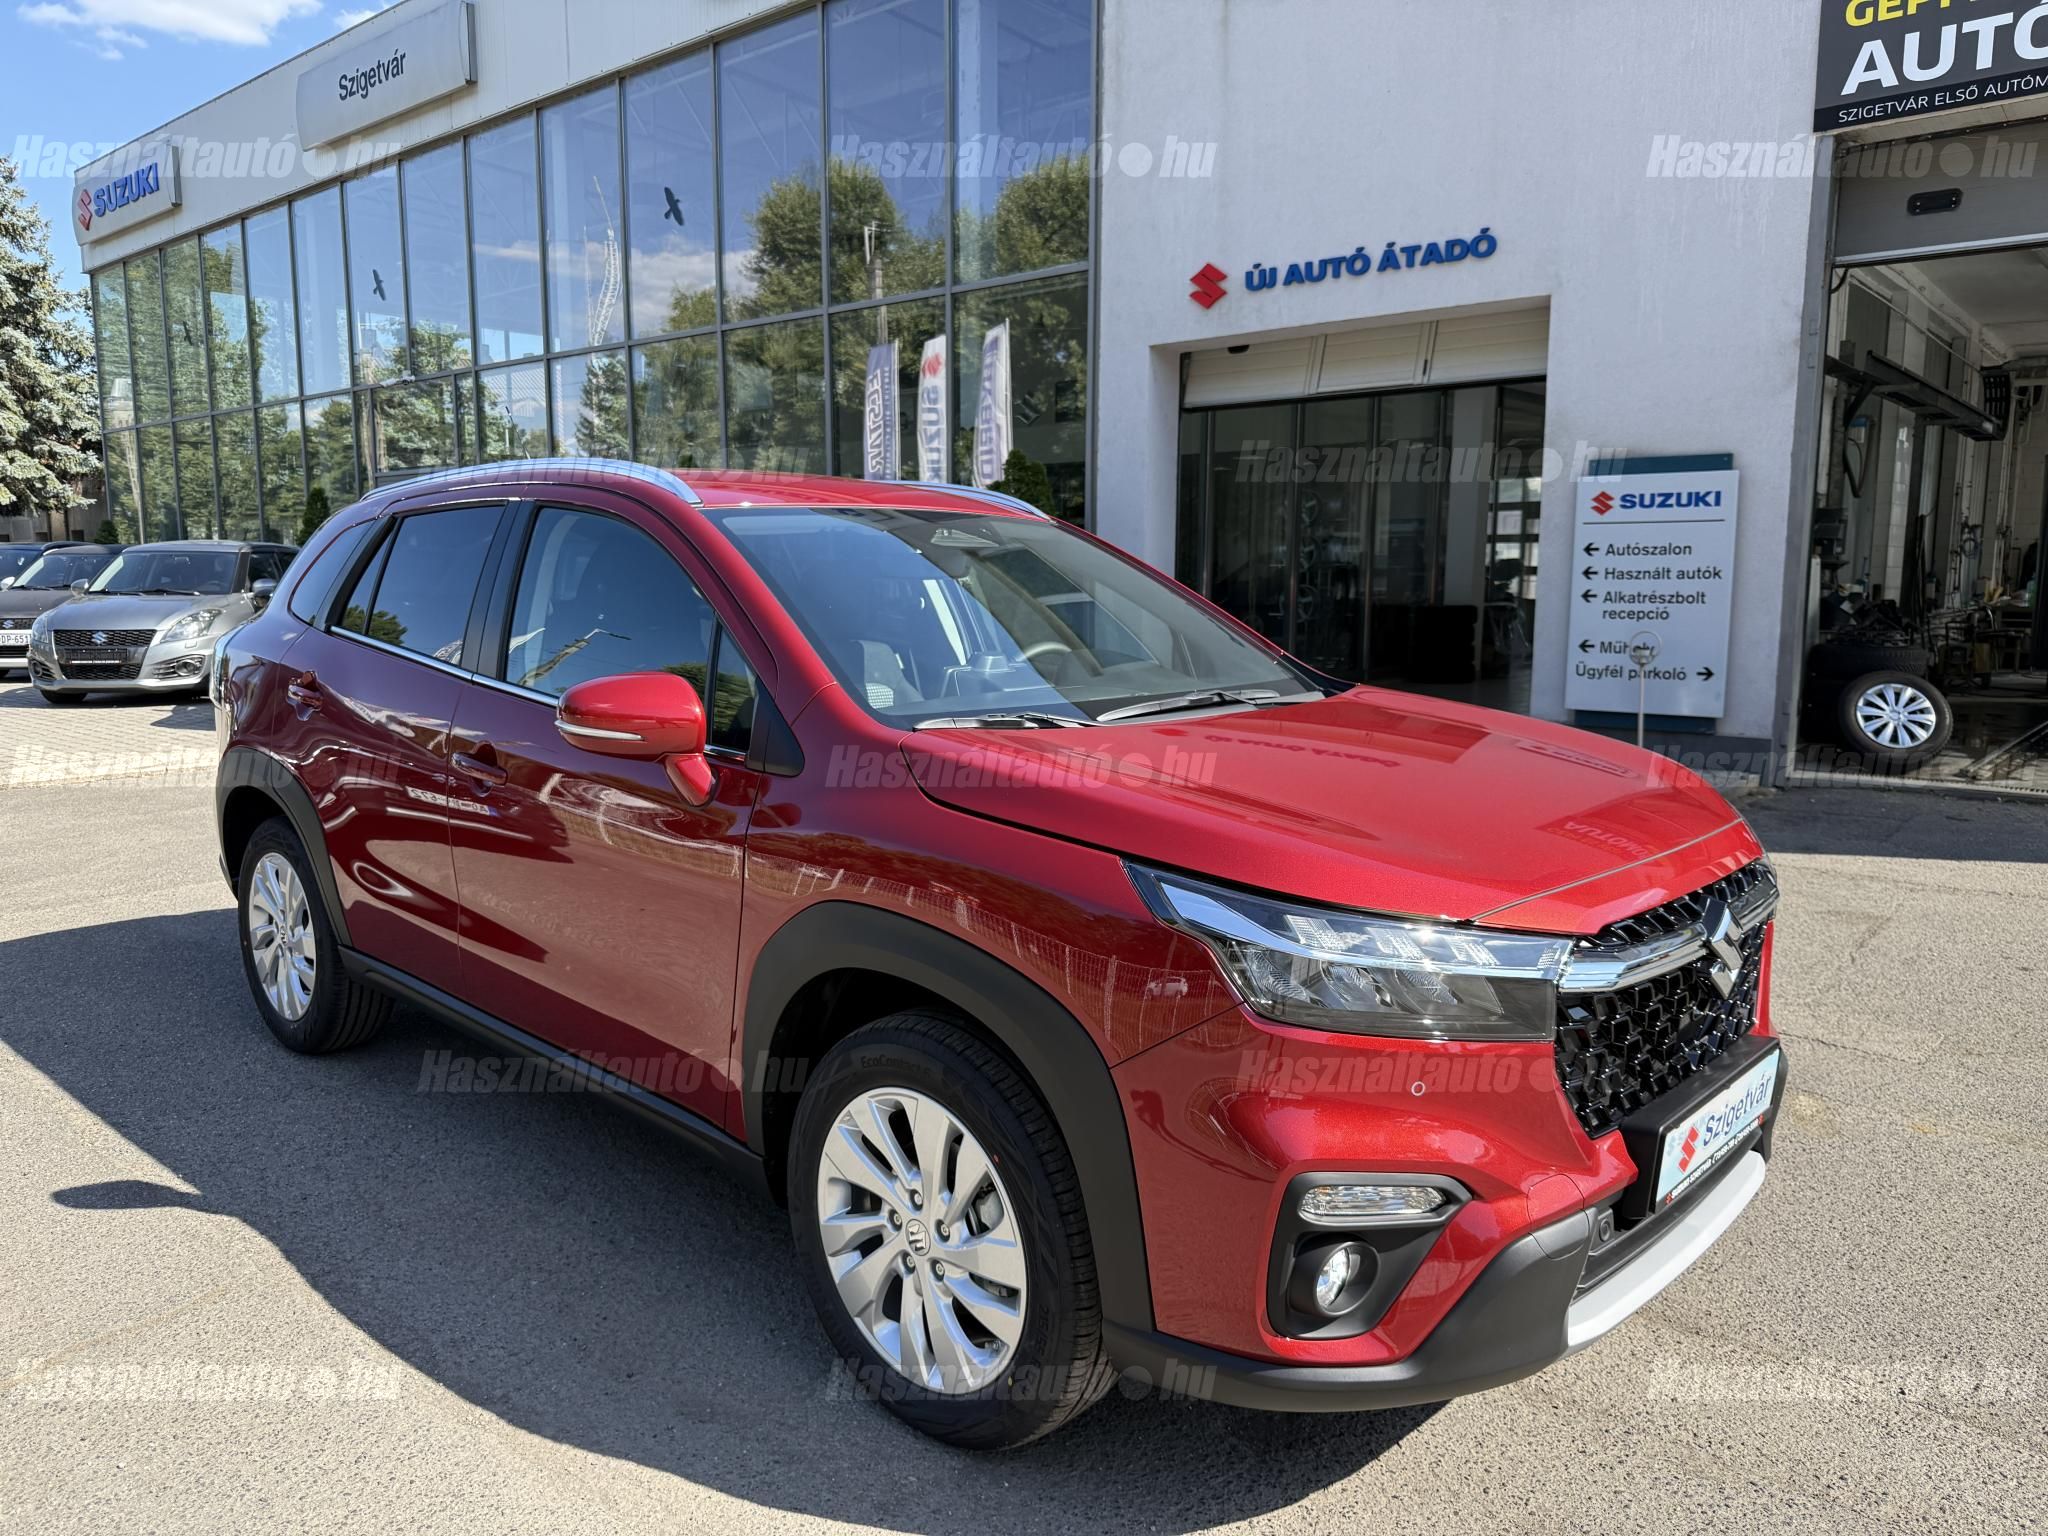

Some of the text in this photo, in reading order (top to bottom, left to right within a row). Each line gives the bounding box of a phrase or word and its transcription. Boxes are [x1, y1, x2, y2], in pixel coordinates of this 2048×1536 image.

[338, 50, 407, 101] Szigetvár
[1838, 96, 1929, 123] SZIGETVÁR
[1935, 85, 1979, 106] ELSŐ
[94, 162, 160, 218] SUZUKI
[1245, 227, 1497, 291] ÚJ AUTÓ ÁTADÓ
[1619, 490, 1721, 509] SUZUKI
[1605, 541, 1693, 556] Autószalon
[1604, 566, 1722, 581] Használt autók
[1602, 590, 1706, 604] Alkatrészbolt
[1602, 607, 1670, 622] recepció
[1703, 1072, 1773, 1147] Szigetvár
